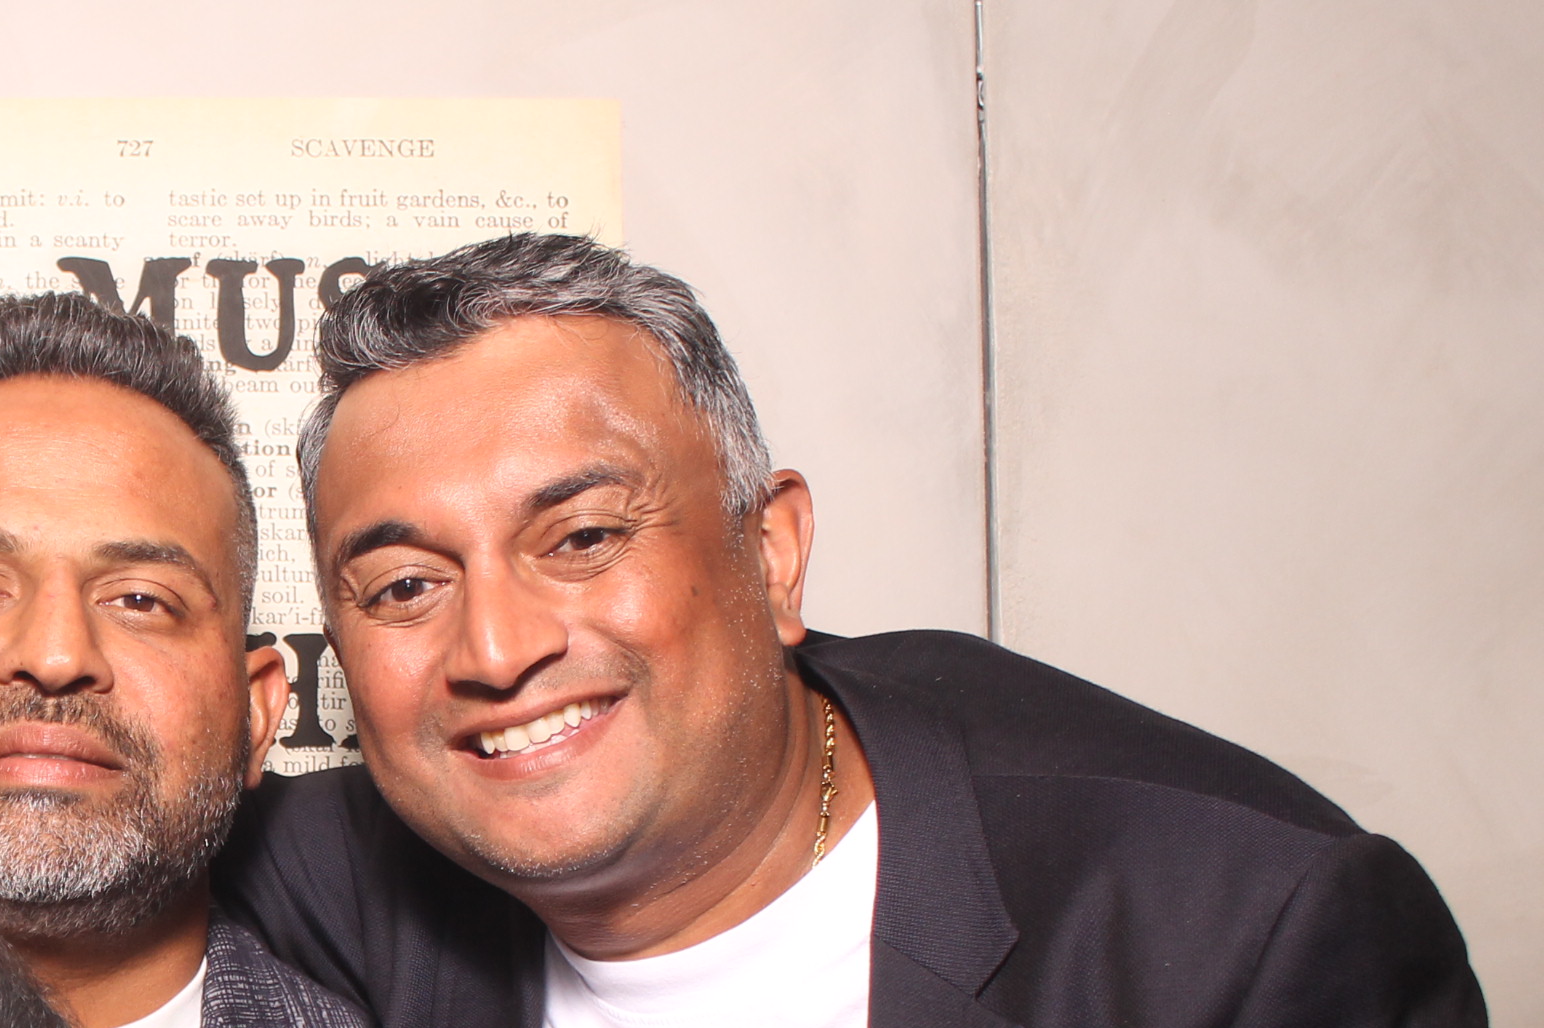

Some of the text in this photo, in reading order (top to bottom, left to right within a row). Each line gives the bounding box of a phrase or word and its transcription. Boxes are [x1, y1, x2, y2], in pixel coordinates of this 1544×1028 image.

[117, 139, 154, 158] 727
[290, 138, 435, 159] SCAVENGE
[104, 190, 125, 207] to
[168, 189, 228, 208] tastic
[235, 190, 266, 207] set
[276, 193, 302, 210] up
[311, 189, 332, 207] in
[340, 189, 388, 207] fruit
[397, 188, 486, 209] gardens,
[547, 191, 569, 209] to
[167, 210, 569, 230] scare away birds; a vain cause of
[30, 235, 42, 248] a
[53, 232, 125, 251] scanty
[169, 234, 237, 248] terror.
[26, 272, 60, 290] the
[261, 585, 305, 604] soil.
